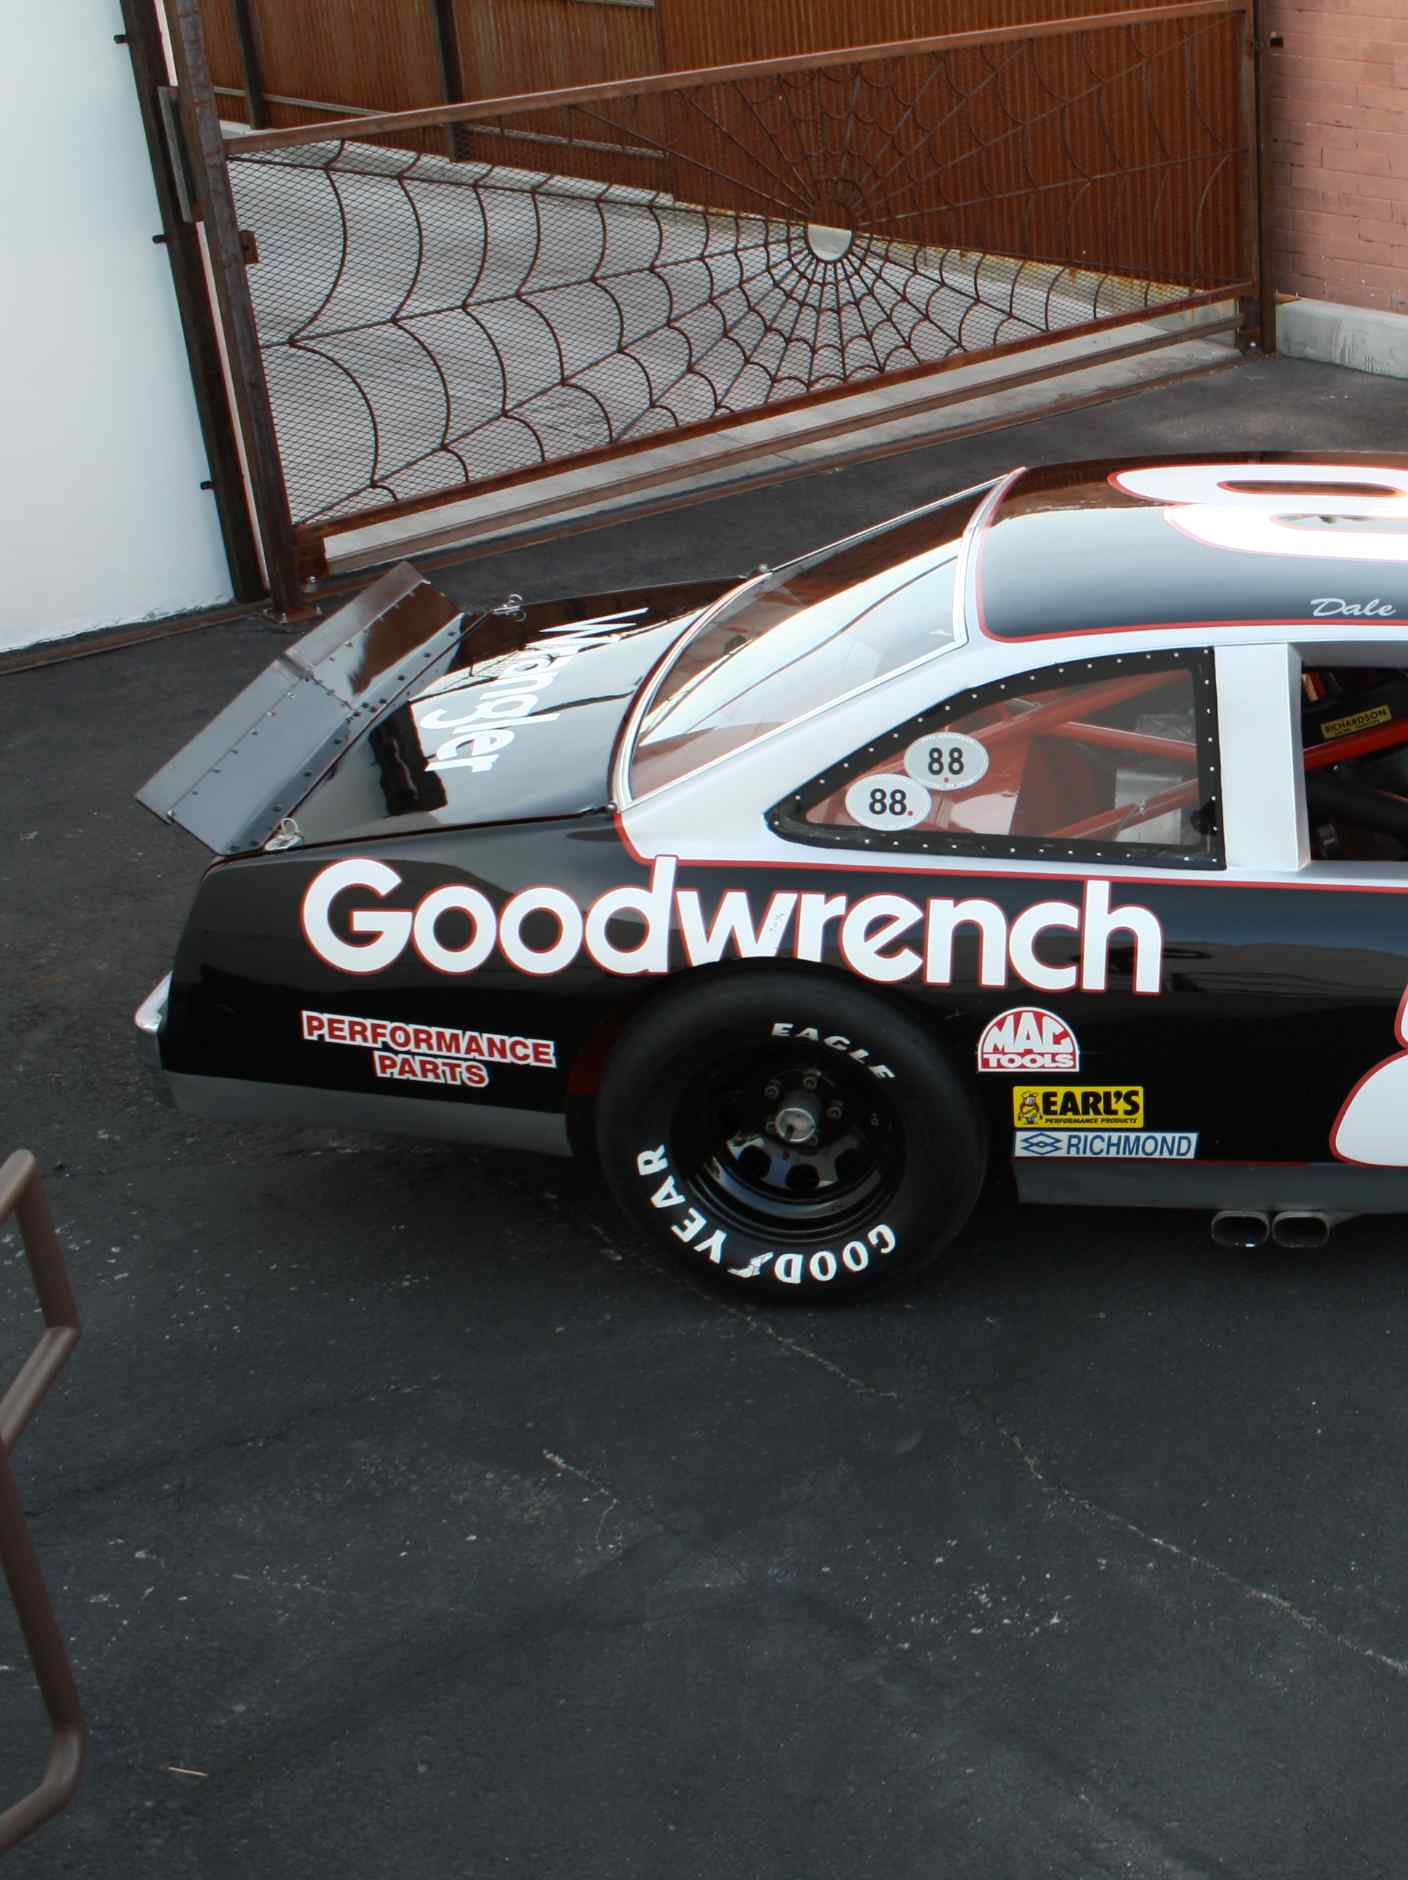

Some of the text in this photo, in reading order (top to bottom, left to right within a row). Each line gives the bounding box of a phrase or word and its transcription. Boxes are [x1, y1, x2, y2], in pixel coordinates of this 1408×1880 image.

[1310, 597, 1397, 618] Dale
[424, 607, 650, 774] Wrangler
[928, 747, 964, 776] 88
[869, 788, 907, 816] 88
[303, 855, 1163, 994] Goodwrench
[301, 1010, 557, 1068] PERFORMANCE
[983, 1011, 1074, 1054] MAC
[770, 1022, 896, 1080] EAGLE
[983, 1053, 1075, 1069] TOOLS
[373, 1051, 489, 1088] PARTS
[1041, 1090, 1141, 1117] EARL'S
[1066, 1134, 1192, 1157] RICHMOND
